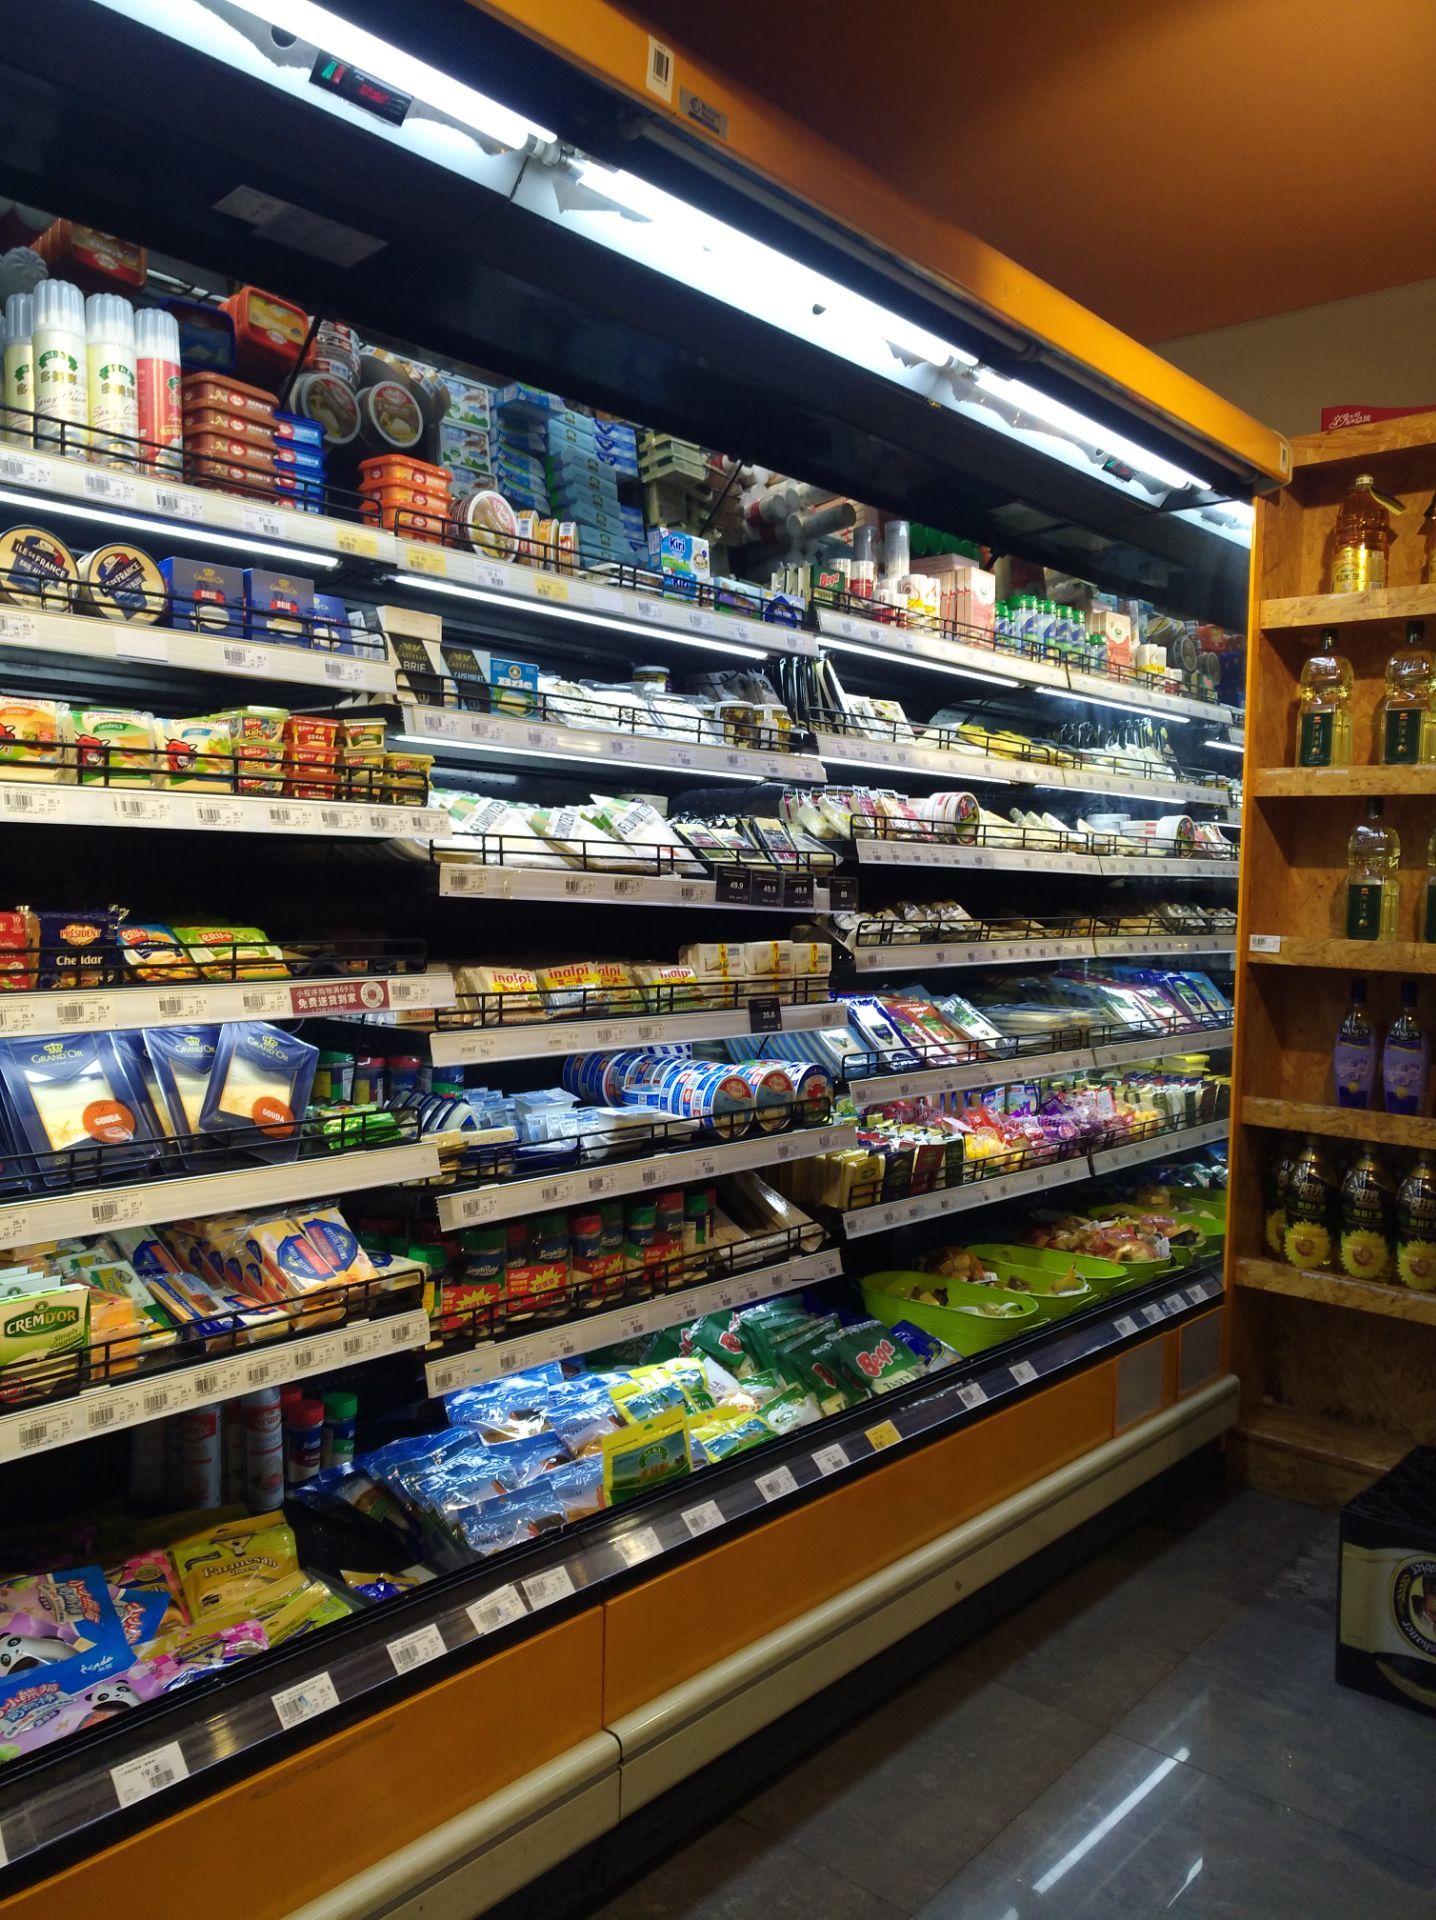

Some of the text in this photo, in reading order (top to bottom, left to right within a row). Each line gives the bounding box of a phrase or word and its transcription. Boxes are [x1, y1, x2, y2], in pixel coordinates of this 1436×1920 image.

[669, 536, 686, 552] Kiri
[15, 543, 28, 557] ILE
[35, 555, 66, 578] FRANCE
[116, 561, 141, 583] FRANCE
[201, 590, 217, 600] BRIE
[276, 600, 292, 611] BRIE
[396, 650, 428, 662] CASTELLO
[447, 660, 479, 671] CASTELLO
[497, 676, 533, 689] Brie
[245, 729, 262, 737] Kids
[729, 881, 744, 890] 49.9
[493, 971, 532, 984] inalpi
[549, 964, 589, 980] inalpi
[598, 965, 621, 977] alpi
[247, 1036, 289, 1062] GRAND'OR
[31, 1050, 83, 1064] GRAND'OR
[93, 1113, 122, 1126] GOUDA
[262, 1107, 285, 1123] GOUDA
[6, 1309, 77, 1335] CREMD'OR
[53, 1327, 79, 1344] Simply
[856, 1339, 895, 1377] Bega
[883, 1374, 914, 1391] TASTY
[202, 1556, 279, 1578] Parmesan
